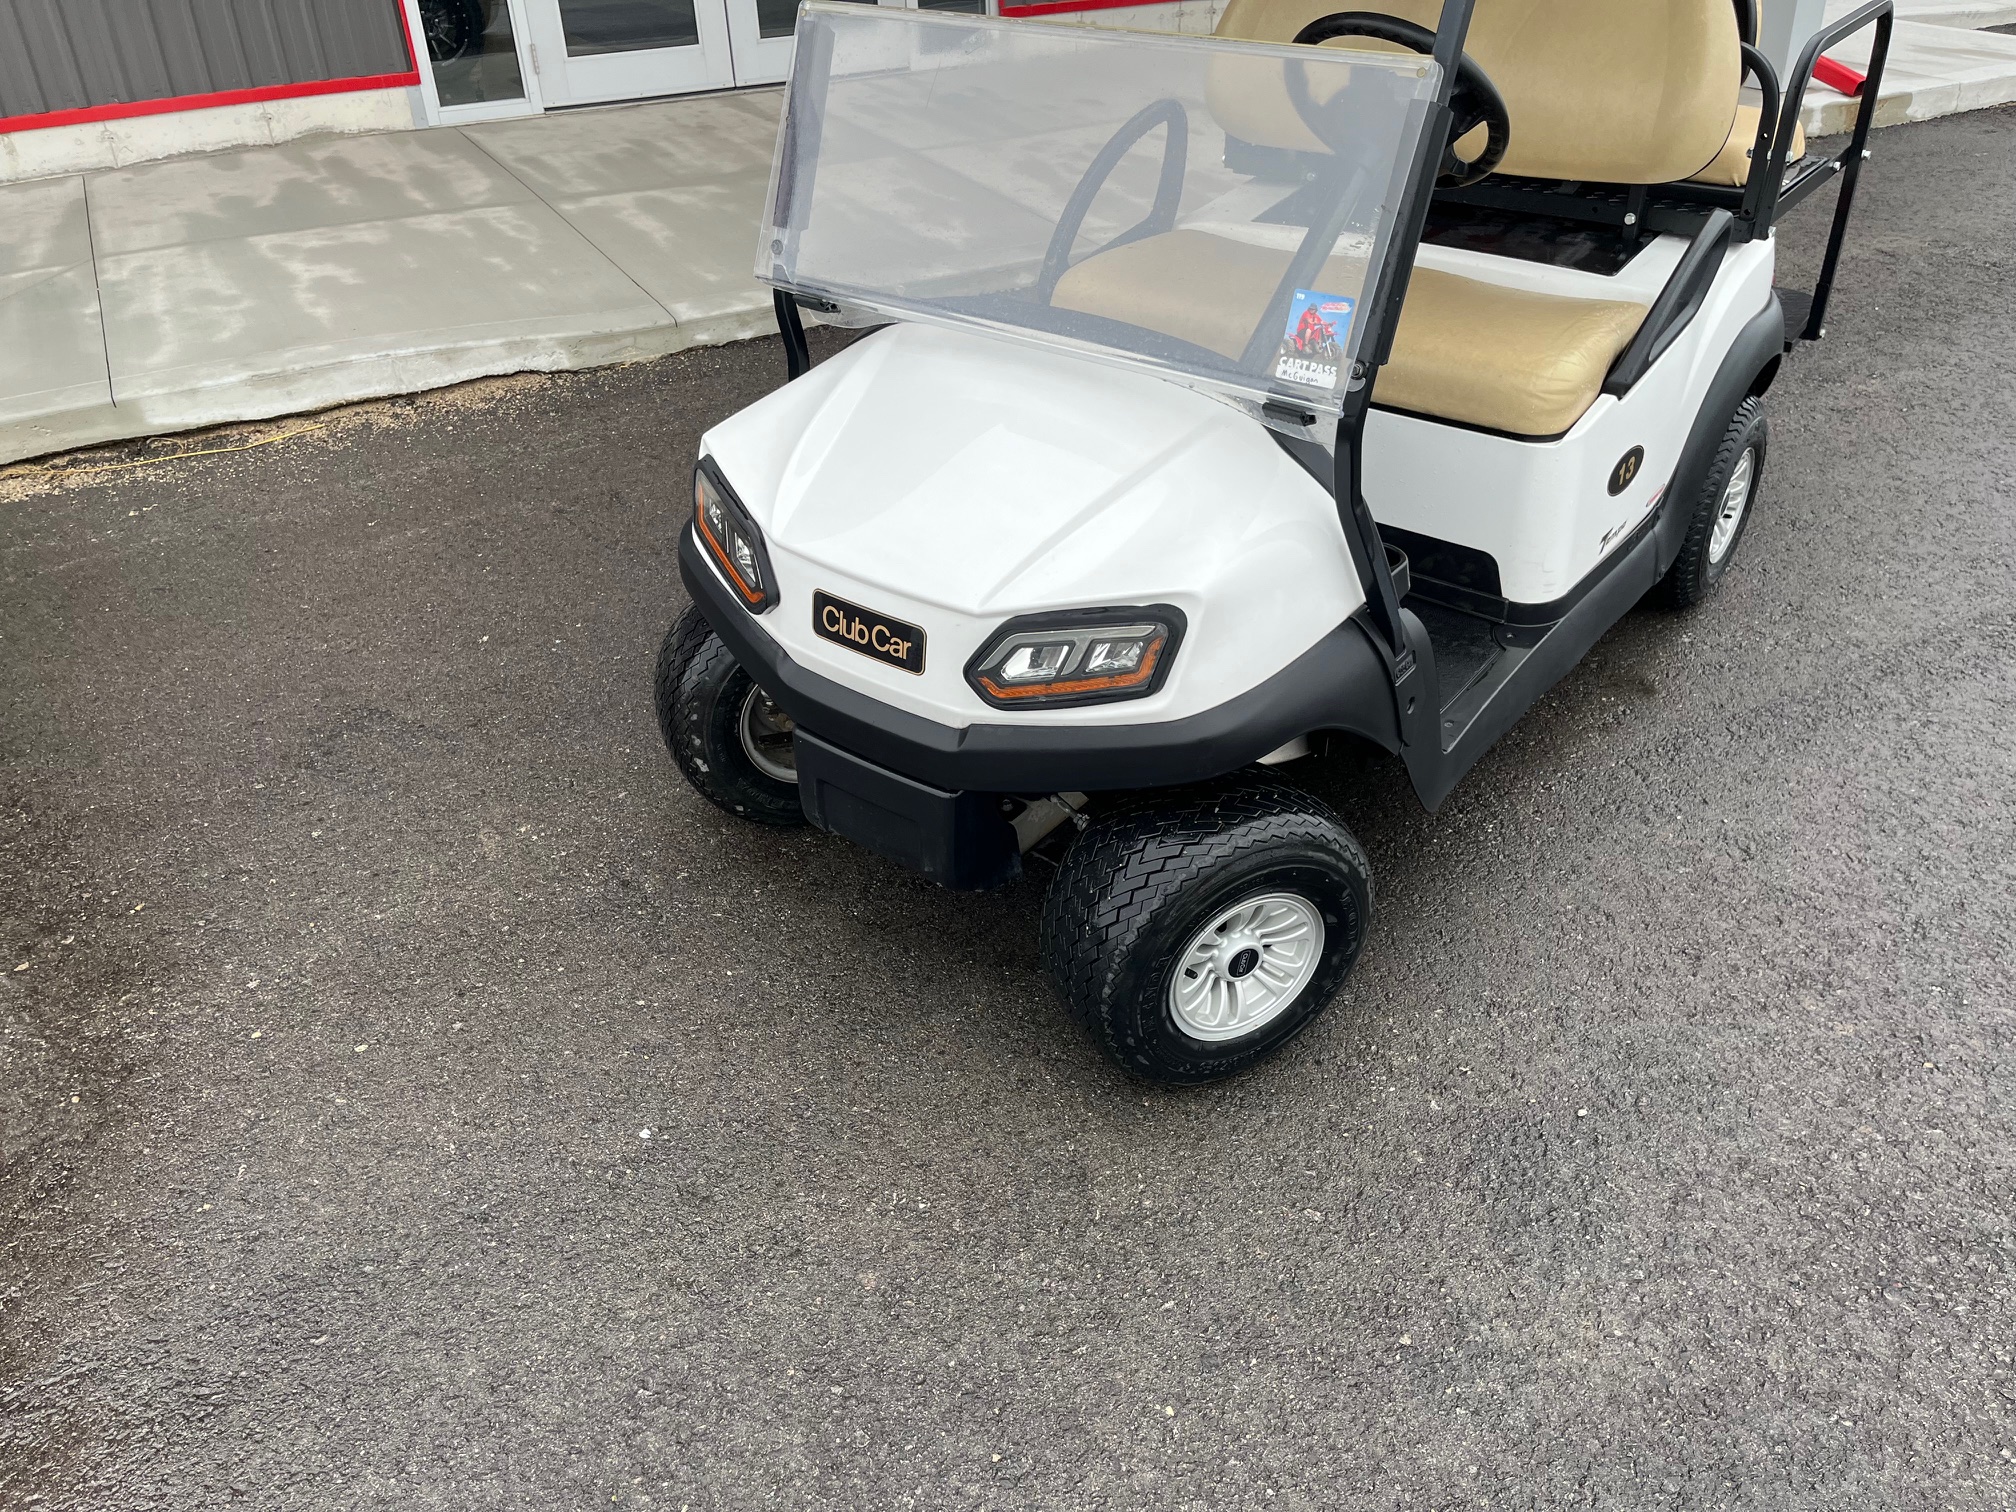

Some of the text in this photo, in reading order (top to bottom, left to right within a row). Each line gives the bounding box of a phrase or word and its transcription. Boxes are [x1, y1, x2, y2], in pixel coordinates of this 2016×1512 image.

[1279, 356, 1337, 376] CART PASS
[1281, 369, 1319, 384] McGuigan
[1618, 456, 1636, 486] 13
[822, 605, 912, 660] Club Car
